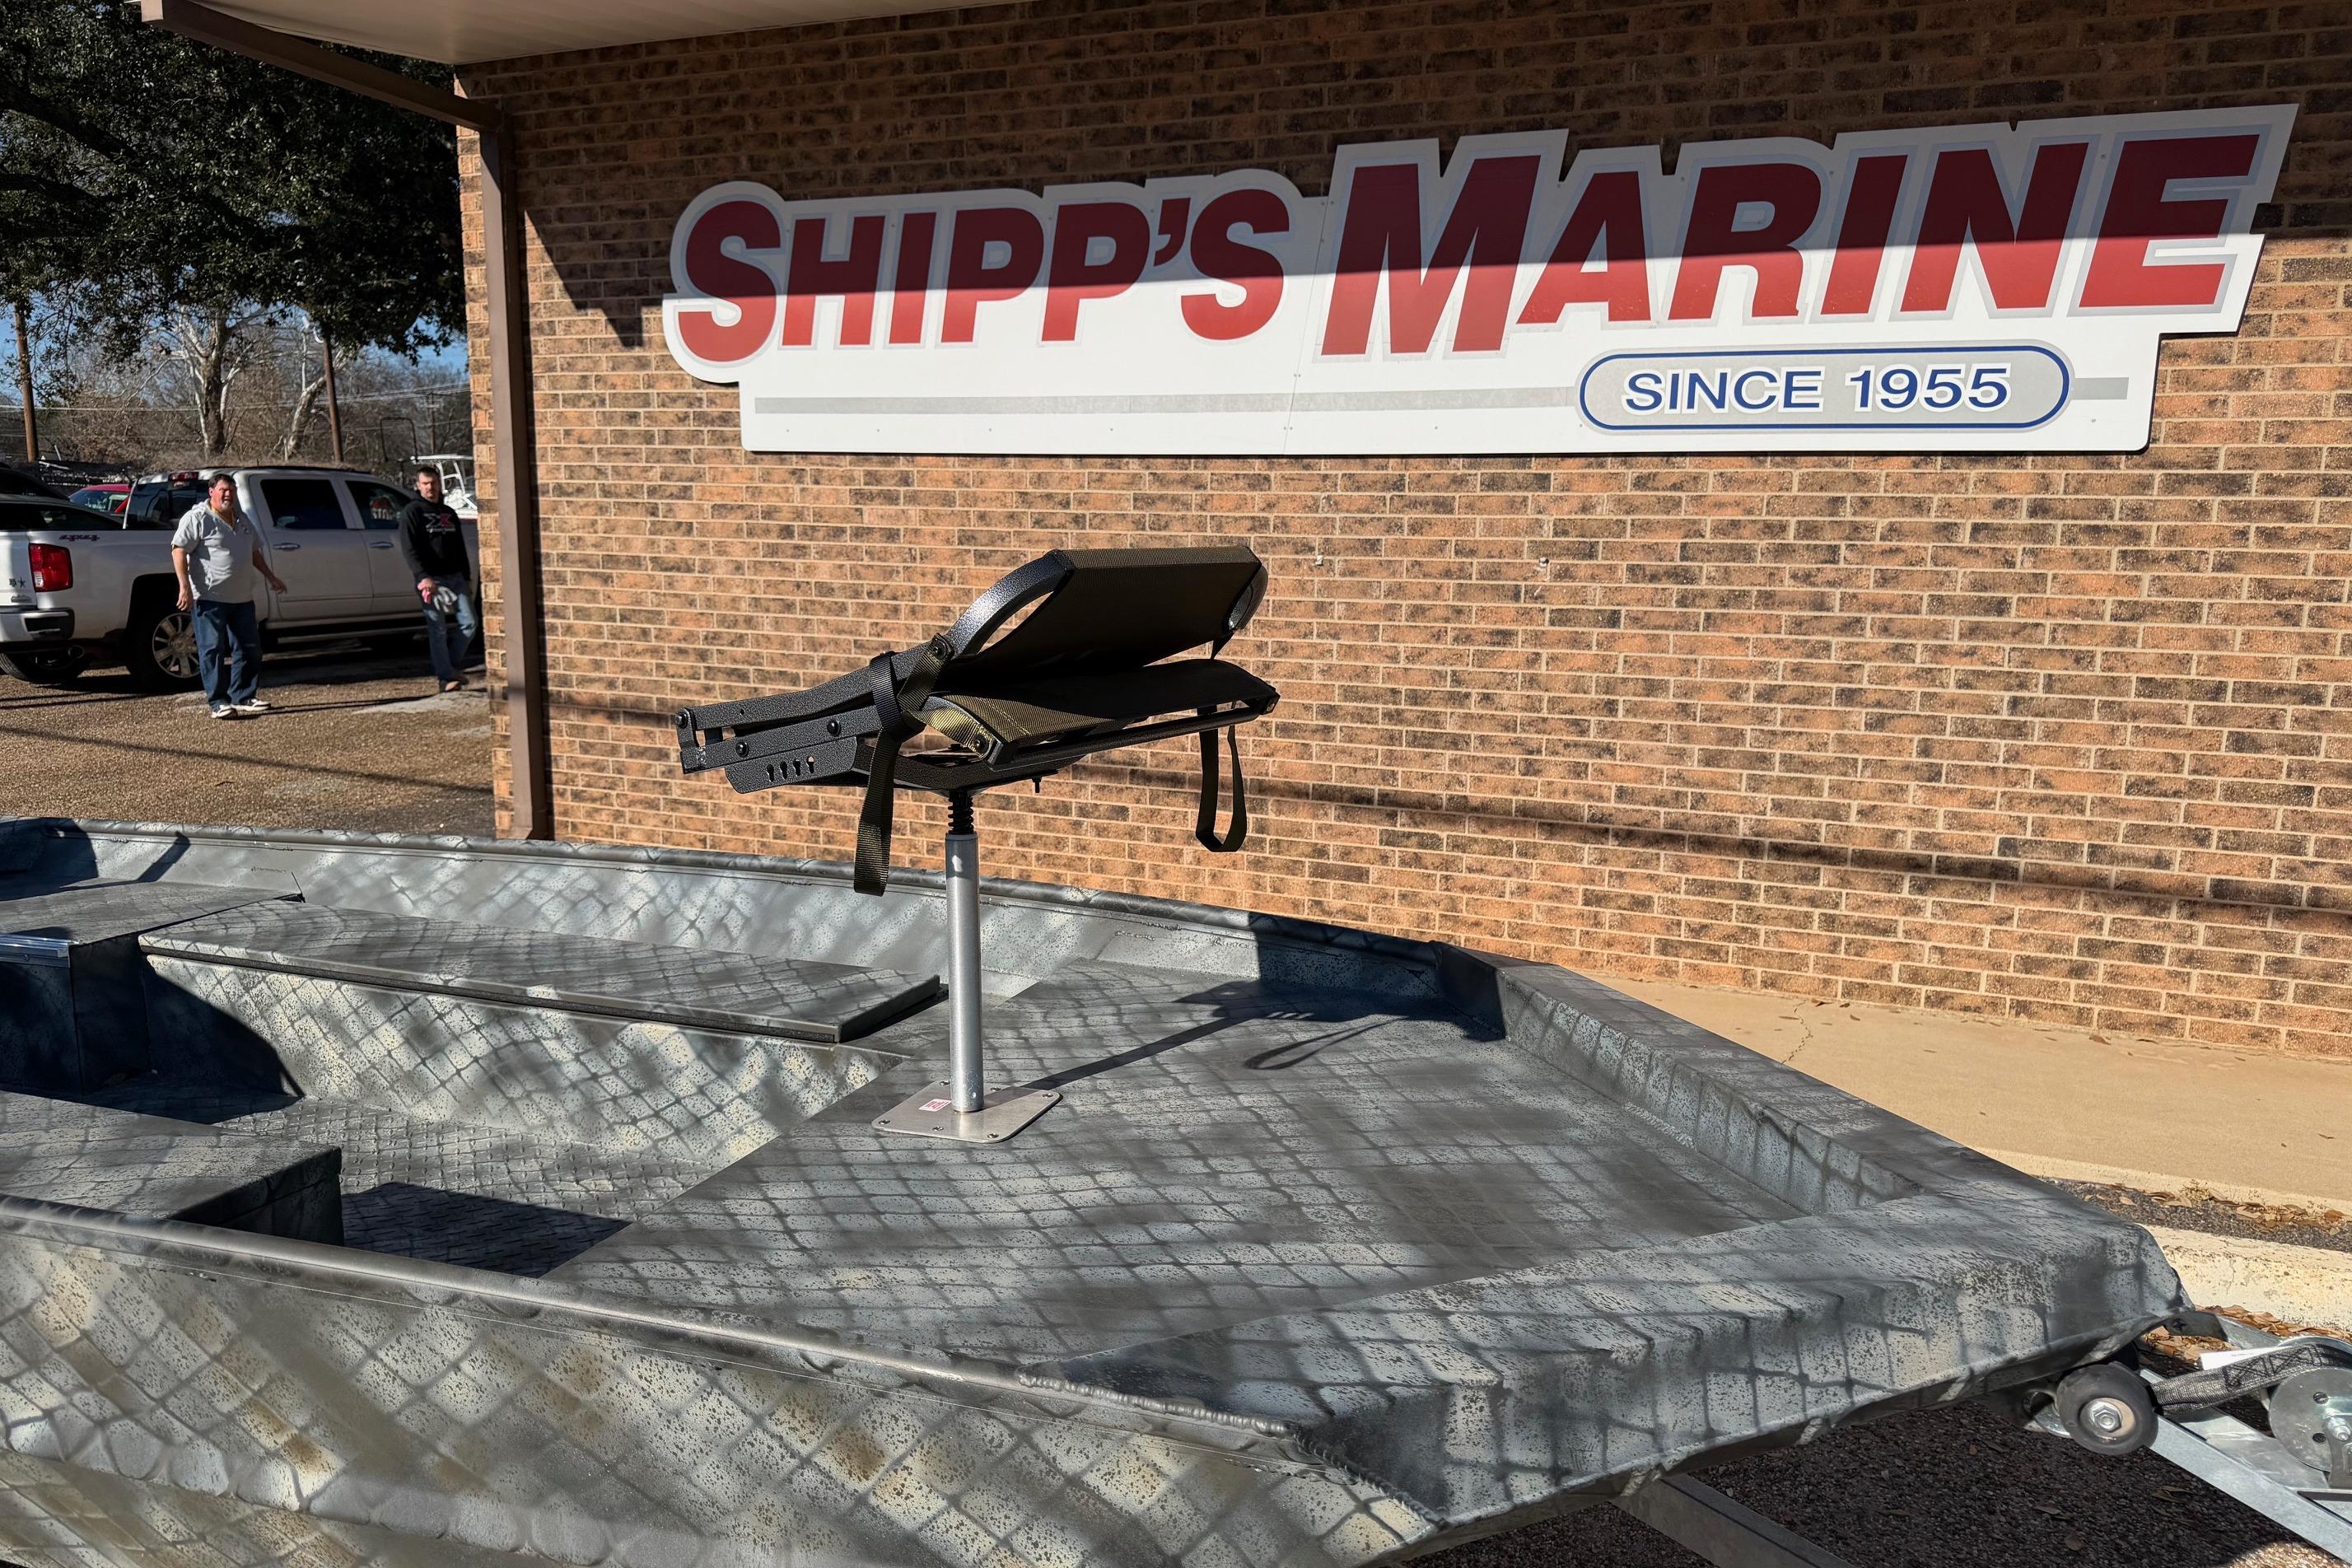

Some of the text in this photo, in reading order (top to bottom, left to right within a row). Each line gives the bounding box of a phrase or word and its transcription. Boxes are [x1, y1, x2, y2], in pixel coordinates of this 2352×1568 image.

[678, 134, 2261, 362] SHIPP'S MARINE
[1625, 367, 2007, 411] SINCE 1955
